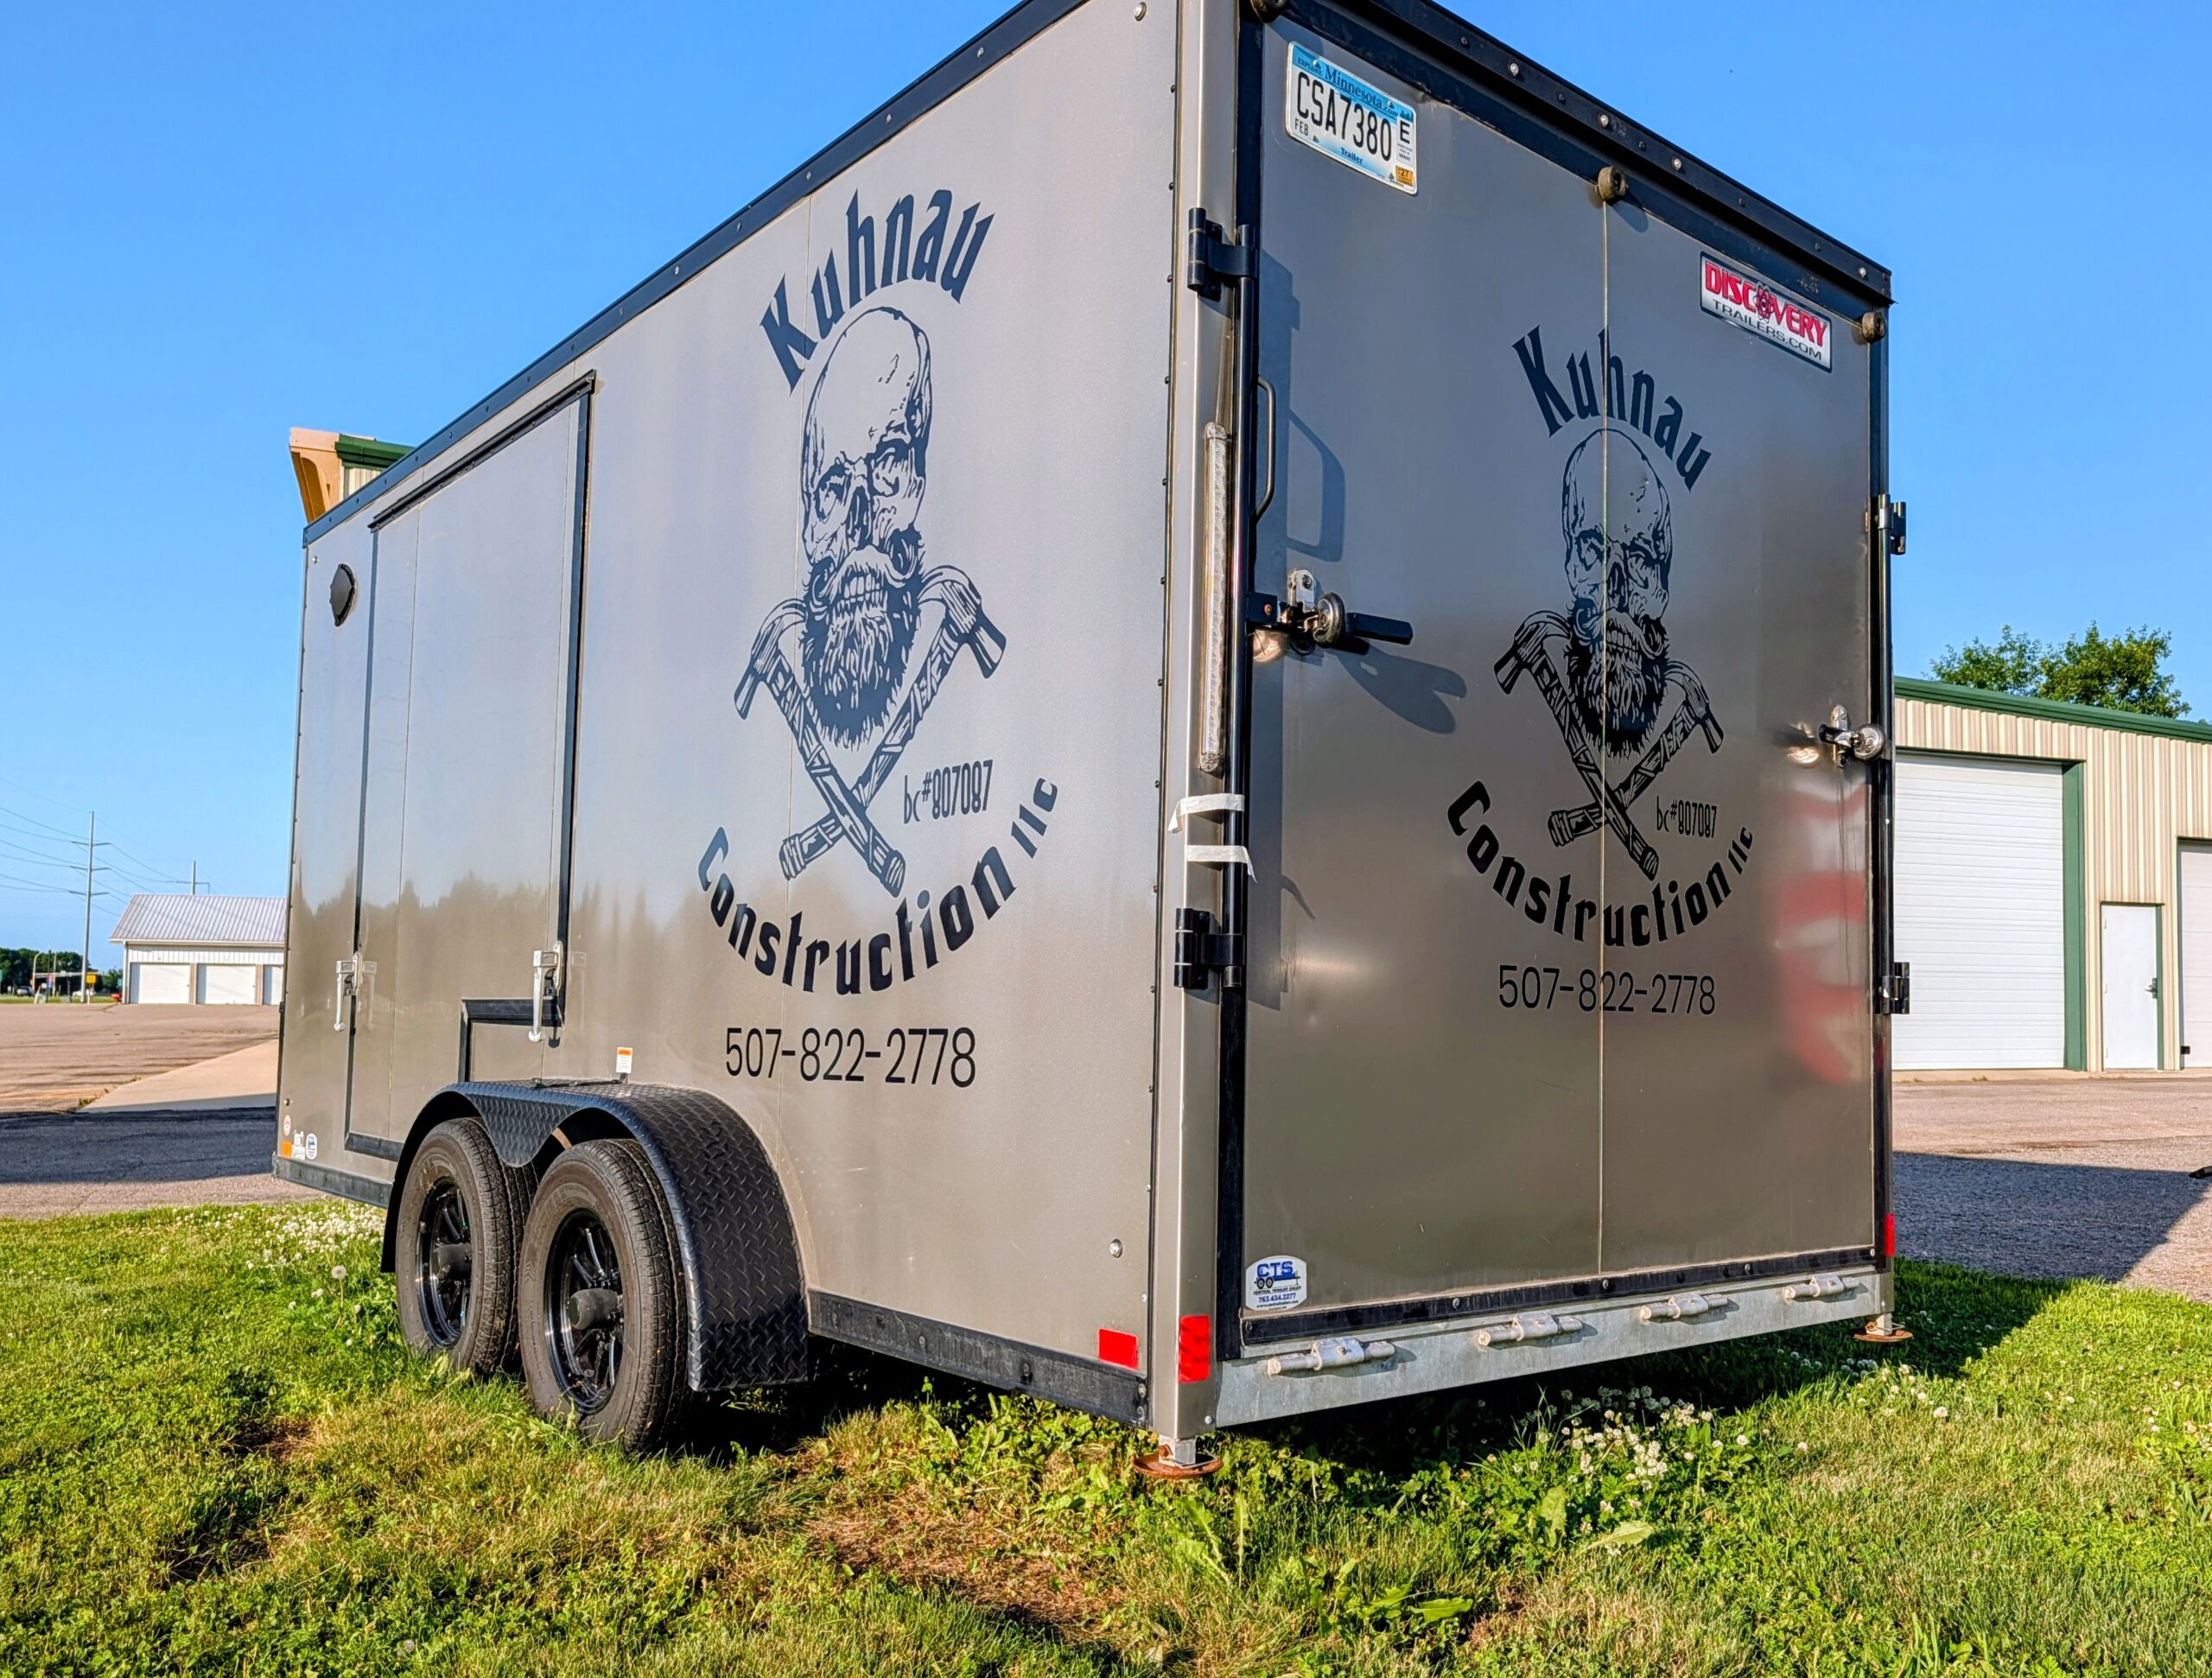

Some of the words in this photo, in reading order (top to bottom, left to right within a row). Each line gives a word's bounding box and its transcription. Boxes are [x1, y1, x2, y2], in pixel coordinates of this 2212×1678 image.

[1294, 118, 1309, 137] FEB
[1297, 71, 1392, 162] CSA7380
[1399, 121, 1411, 145] E
[1340, 146, 1363, 165] Trailer
[760, 188, 995, 397] Kuhnau
[1705, 260, 1828, 347] DISCOVERY
[1712, 299, 1822, 361] TRAILERS.COM
[1511, 325, 1712, 493] Kuhnau
[1447, 780, 1732, 948] Construction
[698, 826, 1017, 995] Construction
[1498, 964, 1716, 1015] 507-822-2778
[725, 1027, 976, 1088] 507-822-2778
[1257, 1261, 1294, 1277] CTS
